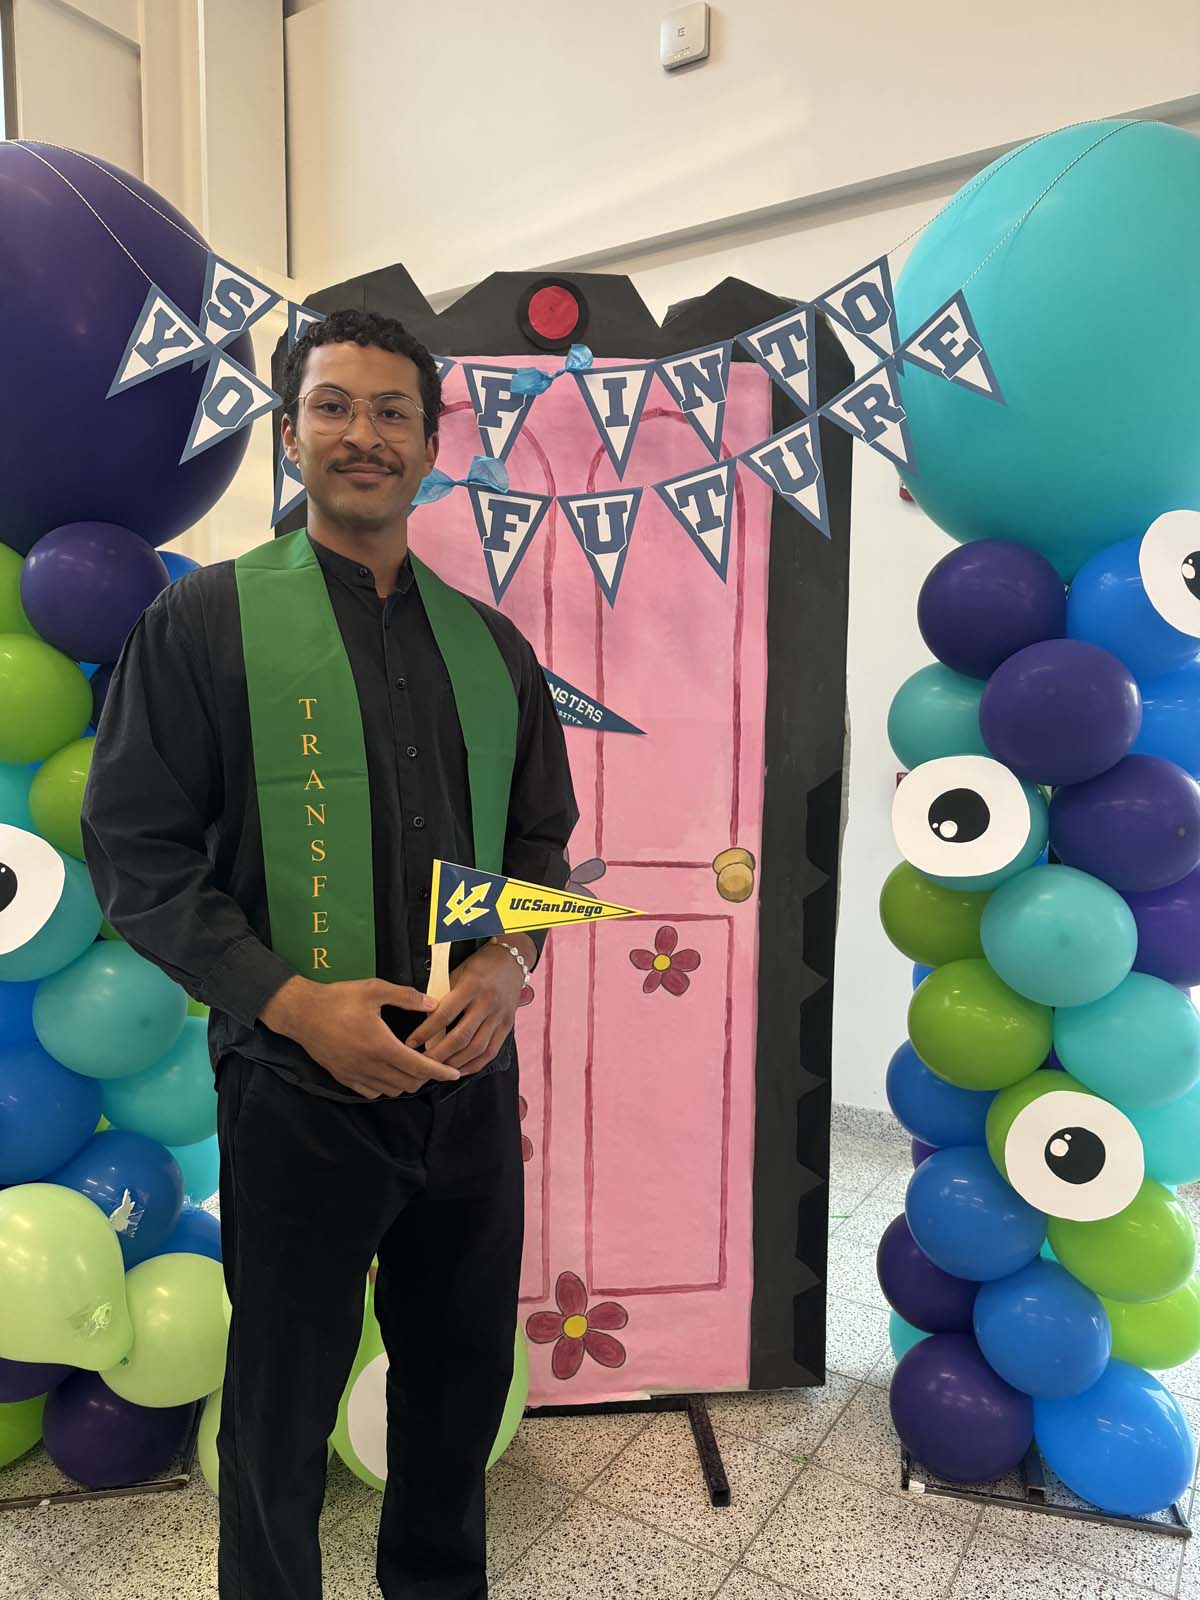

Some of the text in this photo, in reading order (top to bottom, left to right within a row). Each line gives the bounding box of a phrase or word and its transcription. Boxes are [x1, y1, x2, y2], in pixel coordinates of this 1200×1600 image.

[482, 314, 982, 555] FUTURE
[602, 281, 892, 428] INTO
[547, 681, 603, 723] NSTERS
[299, 698, 331, 969] TRANSFER
